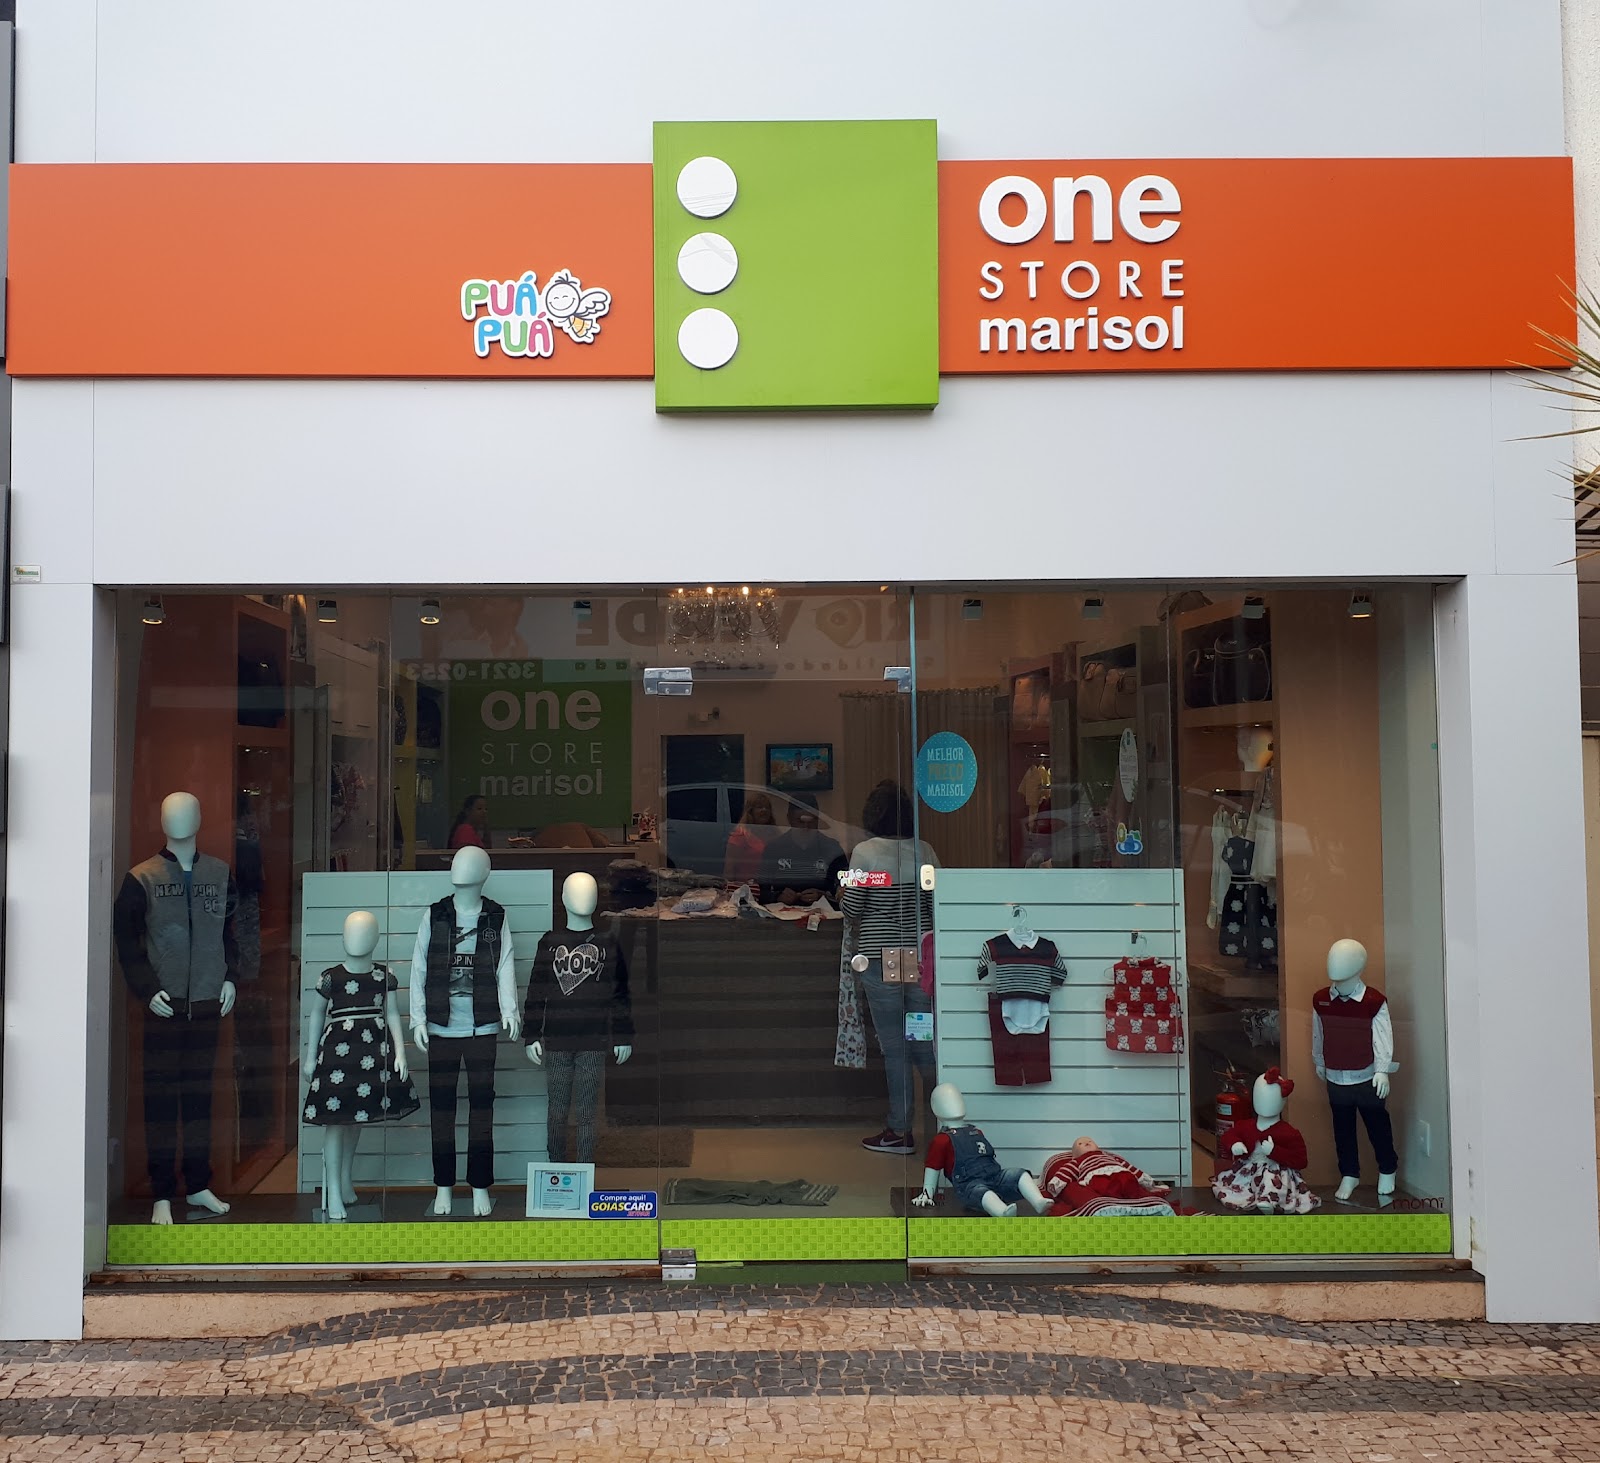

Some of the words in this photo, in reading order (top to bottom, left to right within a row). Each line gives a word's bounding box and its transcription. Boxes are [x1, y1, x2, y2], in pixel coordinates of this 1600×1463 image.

[979, 174, 1182, 244] one
[979, 260, 1184, 300] STORE
[463, 273, 538, 317] PUÁ
[478, 311, 551, 353] PUÁ
[979, 306, 1184, 352] marisol
[480, 689, 602, 731] one
[481, 742, 602, 765] STORE
[927, 747, 964, 761] MELHOR
[480, 768, 602, 796] marisol
[927, 783, 966, 797] MARISOL
[155, 883, 186, 898] NEW
[552, 951, 601, 979] WOW
[591, 1201, 654, 1212] GOIASCARD
[600, 1193, 628, 1203] Compre
[628, 1193, 647, 1203] aqui!
[1392, 1196, 1445, 1211] momi
